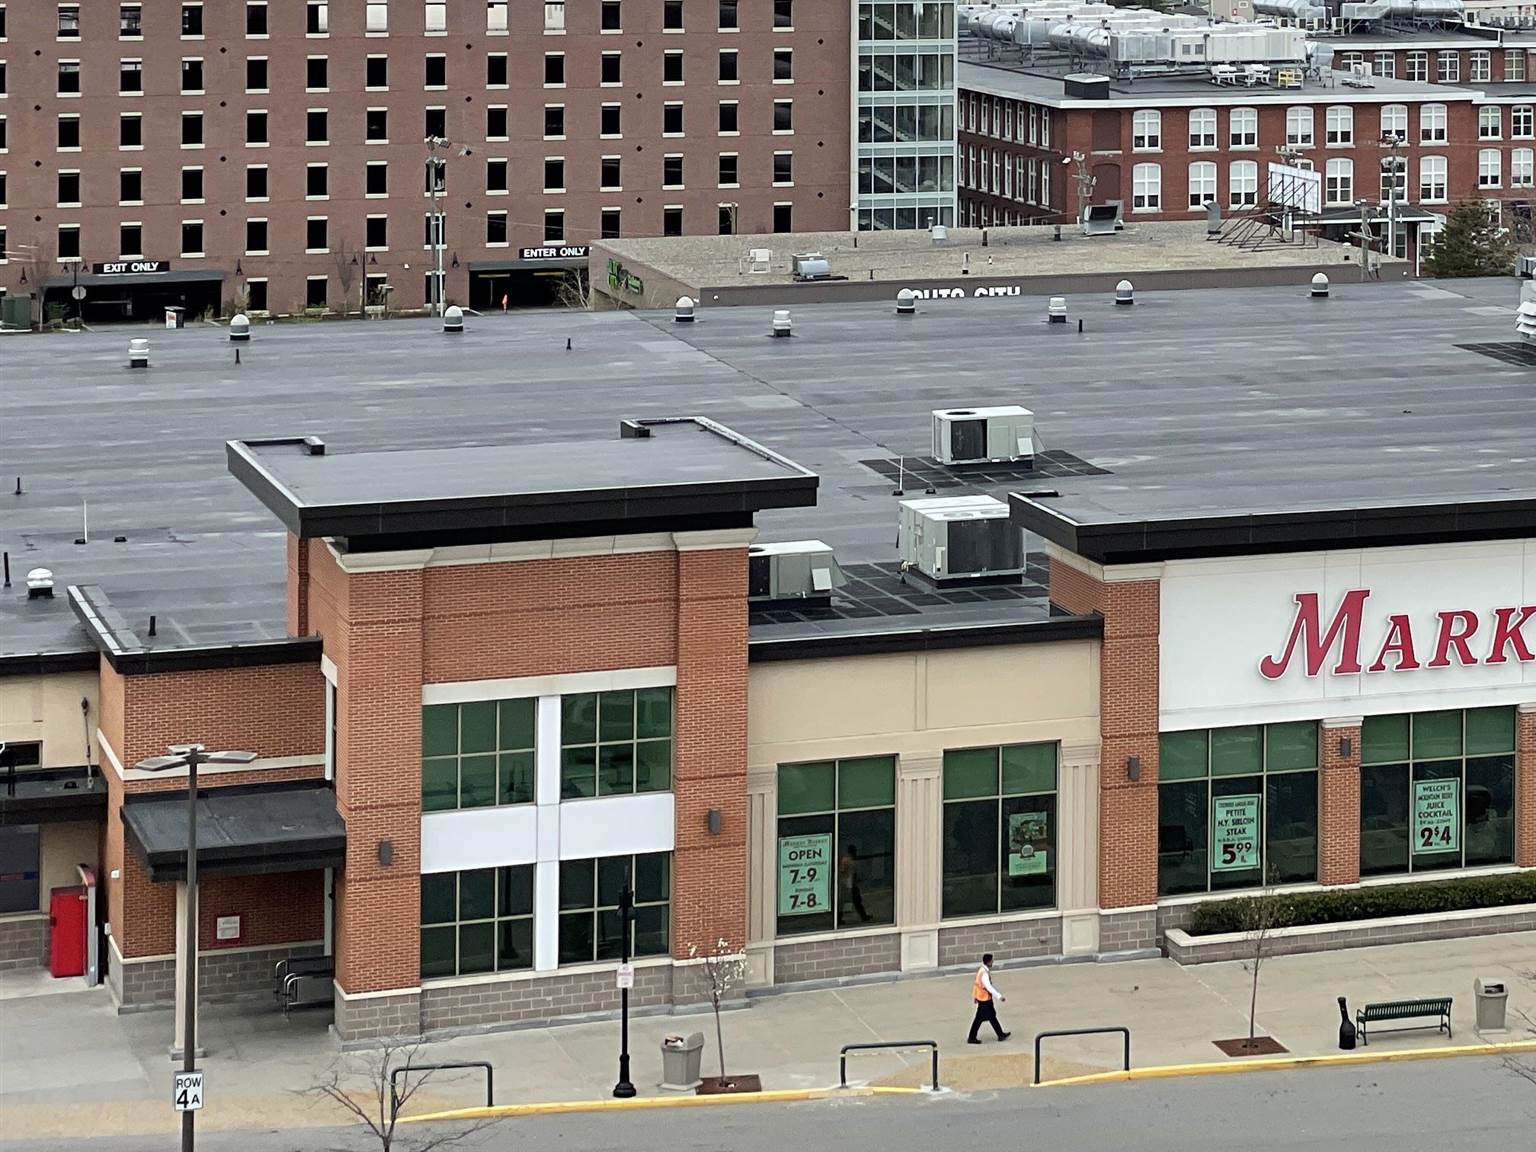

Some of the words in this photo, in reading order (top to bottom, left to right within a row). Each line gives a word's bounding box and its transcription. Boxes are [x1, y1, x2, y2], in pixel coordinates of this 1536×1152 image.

[523, 248, 556, 258] ENTER
[560, 247, 585, 256] ONLY
[103, 263, 127, 273] EXIT
[131, 262, 159, 272] ONLY
[1426, 802, 1445, 810] JUICE
[1226, 809, 1246, 817] PETITE
[1418, 810, 1453, 819] COCKTAIL
[1226, 828, 1247, 836] STEAK
[788, 848, 822, 861] OPEN
[789, 867, 817, 884] 7-9
[789, 893, 816, 910] 7-8
[177, 1077, 202, 1089] ROW
